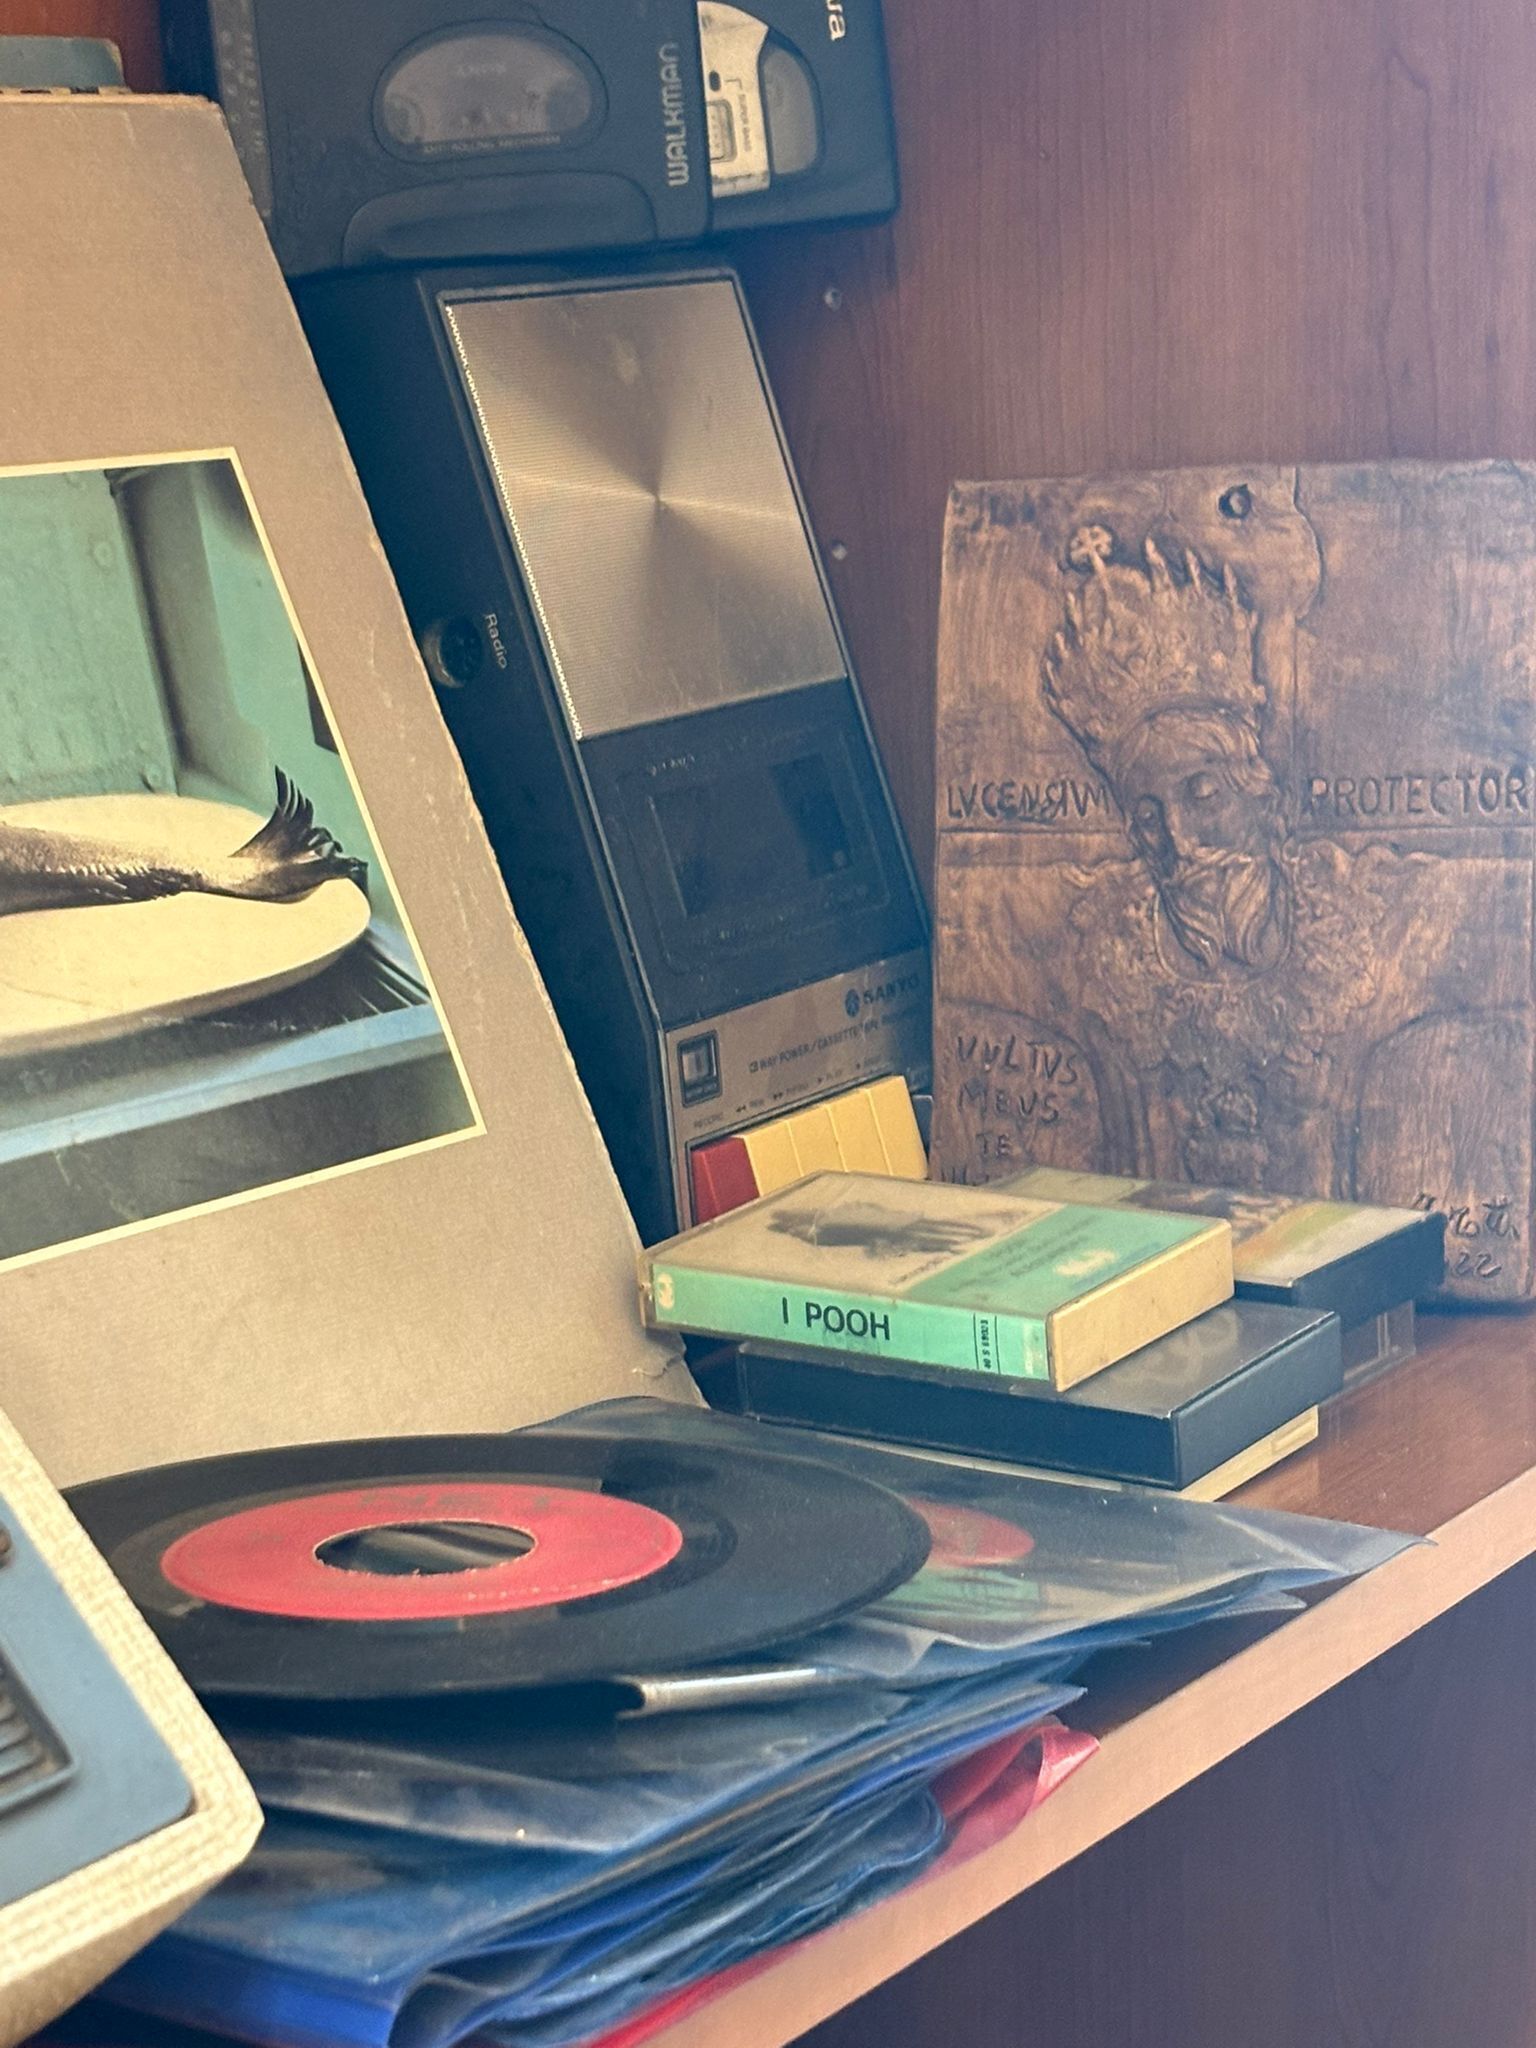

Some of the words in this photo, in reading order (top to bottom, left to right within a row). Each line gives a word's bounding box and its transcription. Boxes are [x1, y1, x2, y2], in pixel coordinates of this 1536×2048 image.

[658, 41, 690, 187] WALKMAN
[485, 613, 508, 669] Radio
[1303, 770, 1529, 815] PROTECTOR
[781, 1296, 790, 1325] I
[804, 1301, 891, 1341] POOH
